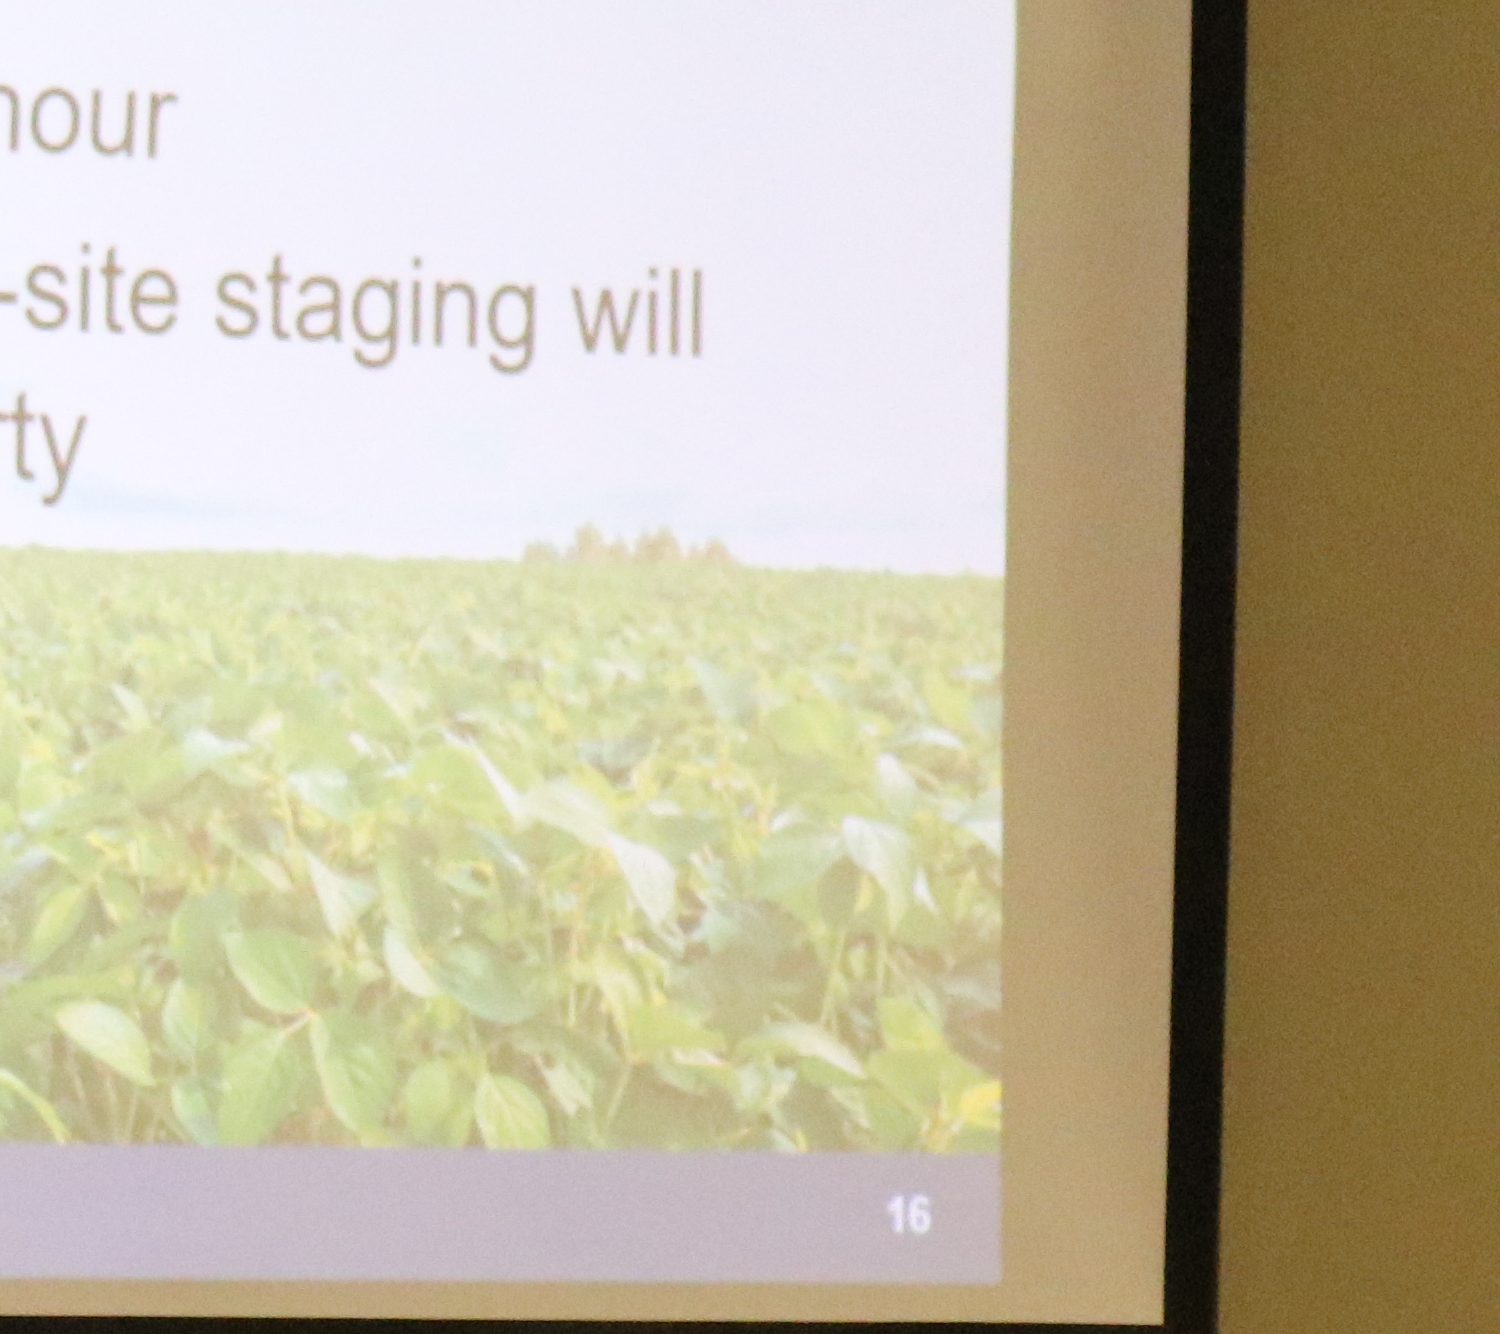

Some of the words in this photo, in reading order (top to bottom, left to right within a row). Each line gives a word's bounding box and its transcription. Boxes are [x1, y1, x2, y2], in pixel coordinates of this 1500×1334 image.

[213, 253, 539, 378] staging
[569, 265, 705, 359] will
[886, 1192, 932, 1235] 16
